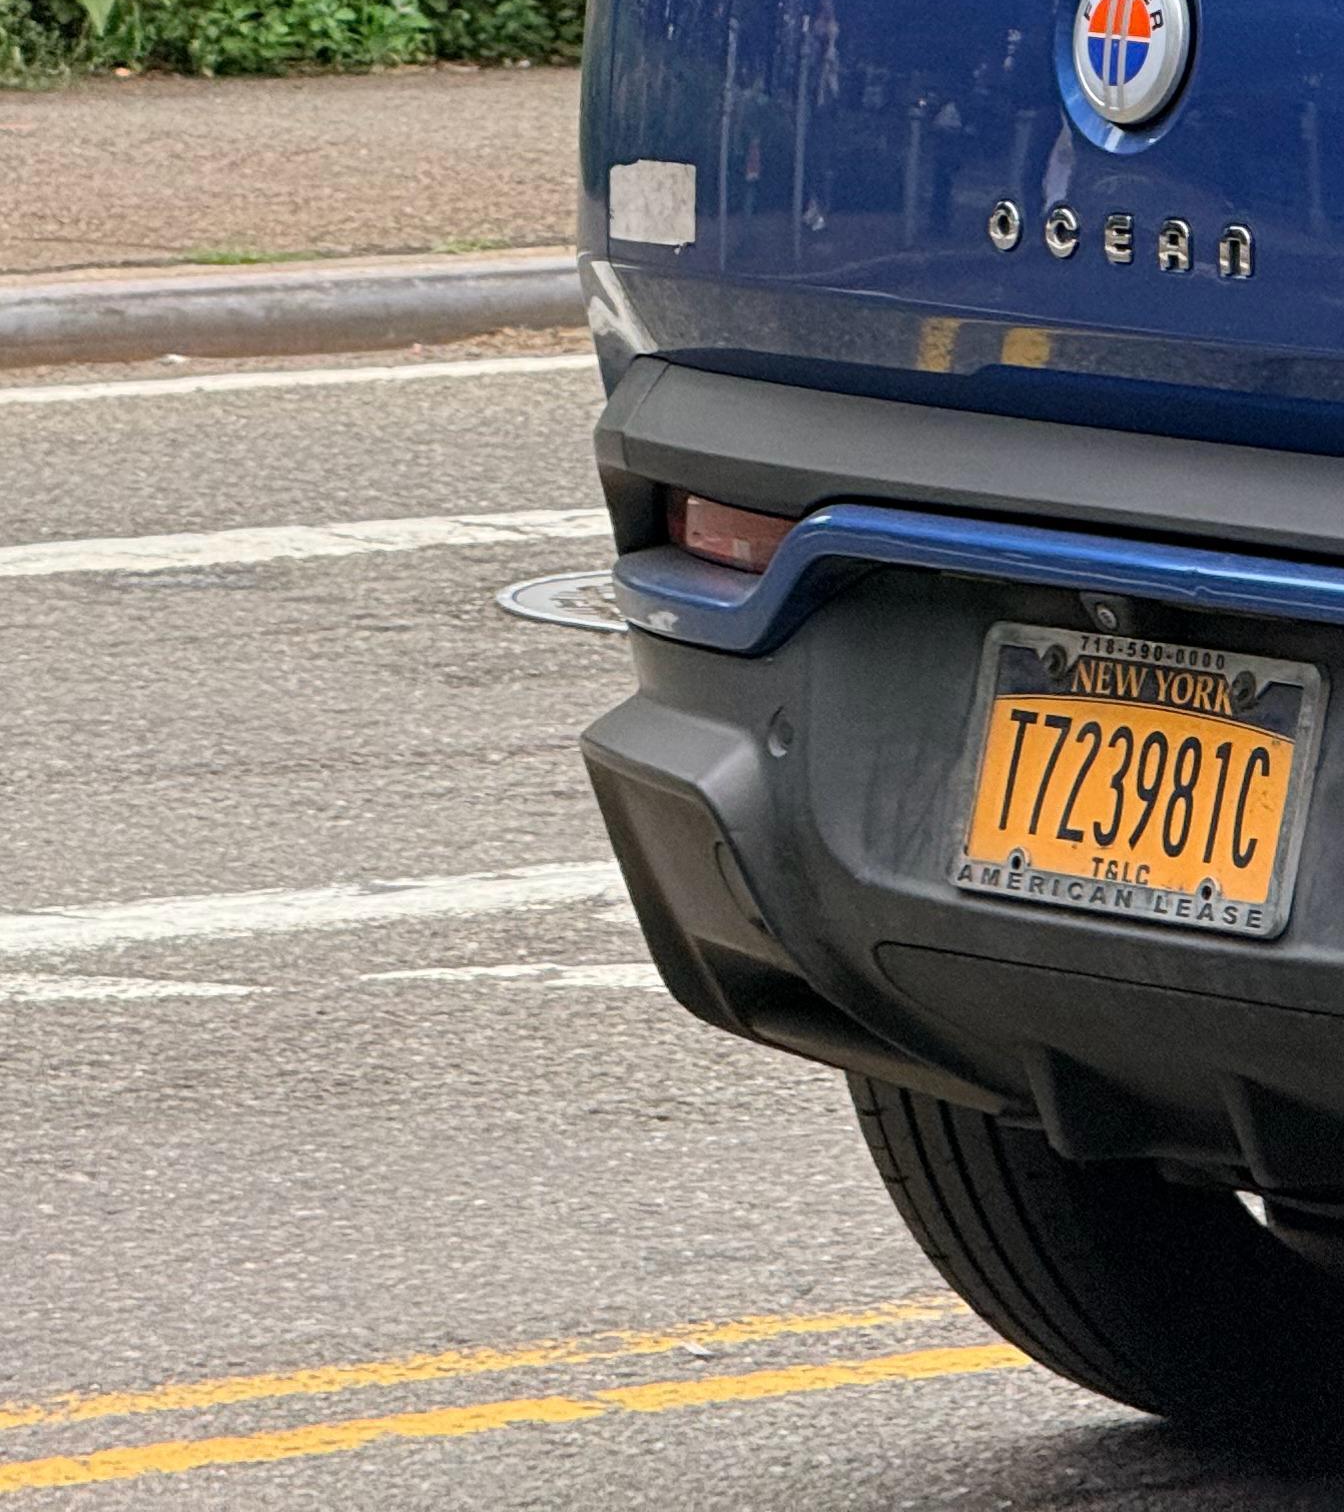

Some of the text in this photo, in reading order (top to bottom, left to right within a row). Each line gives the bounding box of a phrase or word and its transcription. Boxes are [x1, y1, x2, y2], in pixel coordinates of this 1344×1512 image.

[1080, 635, 1226, 670] 718-590-0000
[1071, 659, 1233, 717] NEW YORK
[998, 708, 1271, 870] T723981C
[957, 863, 1265, 930] AMERICAN LEASE
[1091, 856, 1151, 886] T&LC
